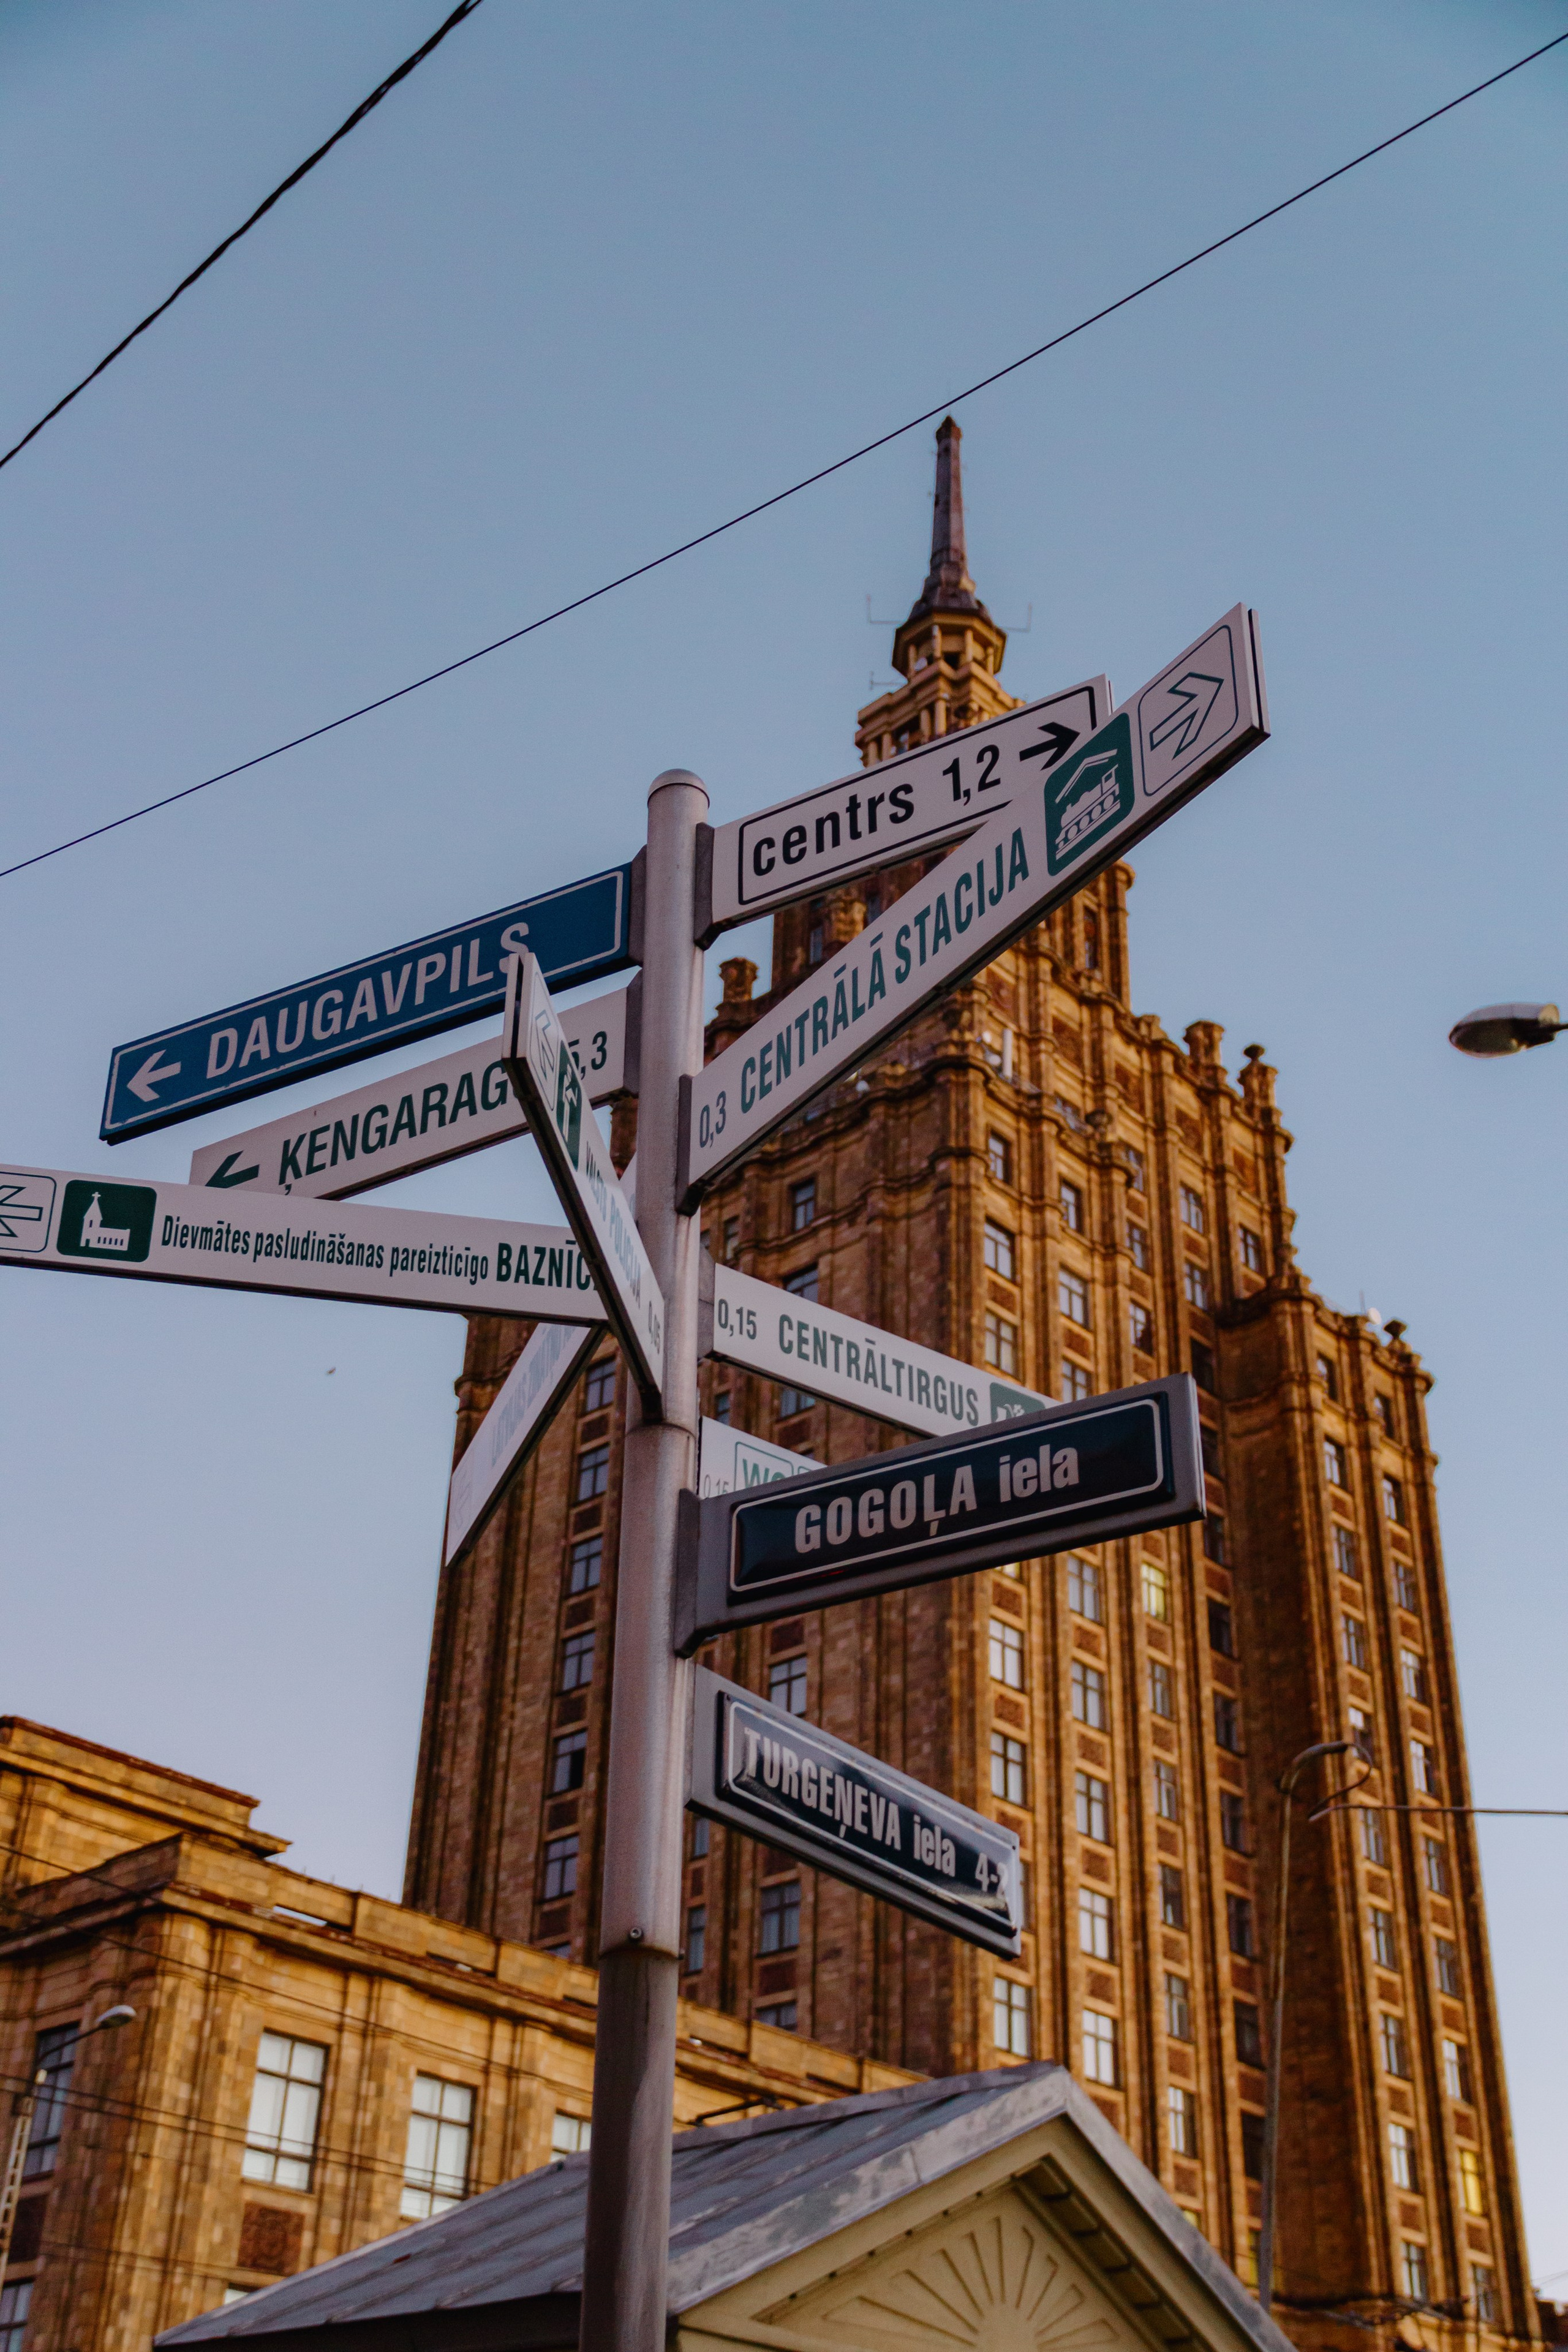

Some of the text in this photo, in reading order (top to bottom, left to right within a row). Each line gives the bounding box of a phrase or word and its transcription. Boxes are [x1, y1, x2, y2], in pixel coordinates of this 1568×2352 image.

[753, 745, 1000, 876] centrs 1,2
[206, 922, 529, 1079] DAUGAVPILS
[699, 827, 1030, 1148] 0,3 CENTRĀLĀ STACIJA
[279, 1059, 519, 1196] ĶENGARAG
[161, 1215, 598, 1291] Dievmātes pasludināšanas pareizticīgo BAZNĪC
[717, 1298, 979, 1427] 0,15 CENTRĀLTIRGUS
[795, 1444, 1079, 1553] GOGOĻA iela
[744, 1727, 902, 1839] TURGEŅEVA
[913, 1814, 956, 1877] iela
